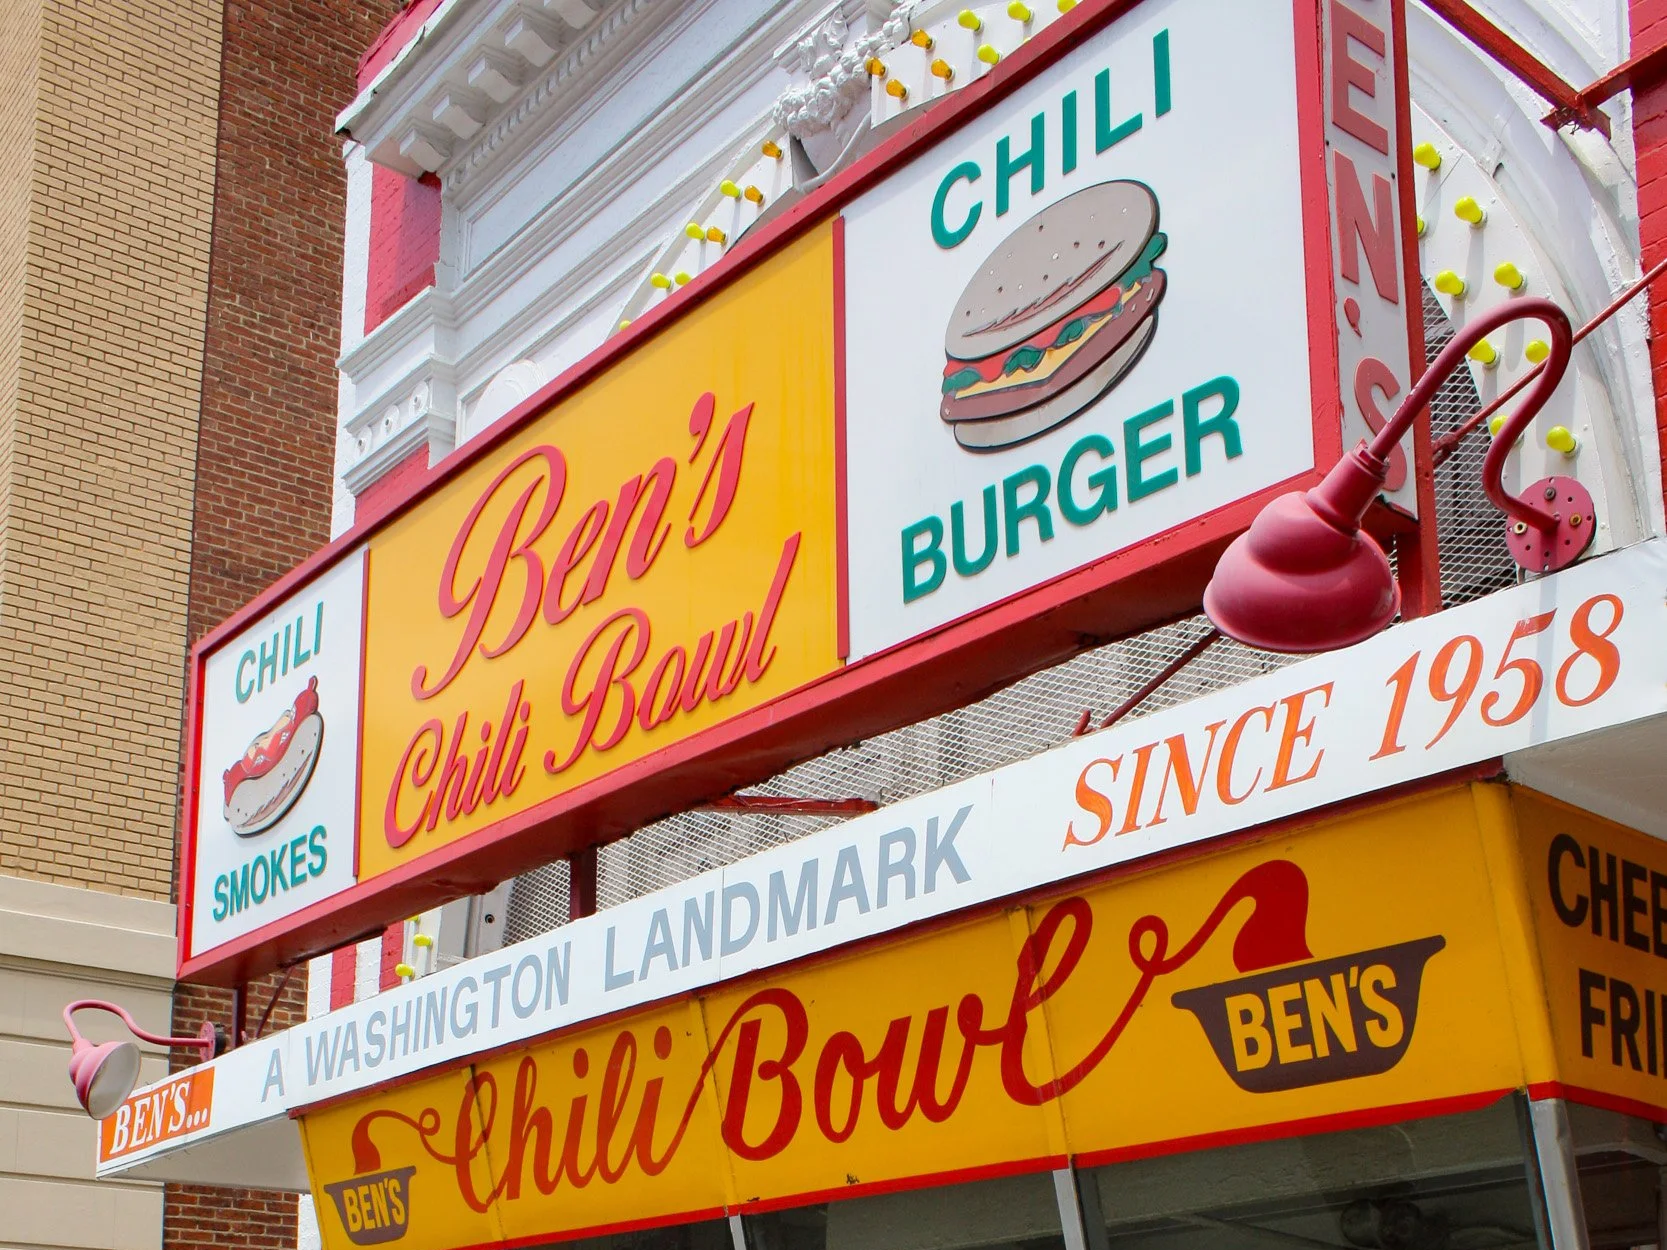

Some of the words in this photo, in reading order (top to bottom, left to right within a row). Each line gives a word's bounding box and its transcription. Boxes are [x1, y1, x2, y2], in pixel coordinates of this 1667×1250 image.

[930, 27, 1174, 251] CHILI
[411, 391, 755, 700] Ben's
[901, 374, 1244, 604] BURGER
[235, 601, 325, 704] CHILI
[384, 679, 531, 849] Chili
[543, 606, 802, 774] Bowl
[212, 824, 329, 923] SMOKES
[261, 1047, 286, 1103] A
[304, 941, 572, 1087] WASHINGTON
[604, 804, 974, 993] LANDMARK
[1062, 680, 1336, 852] SINCE
[1369, 591, 1627, 763] 1958
[455, 1022, 702, 1213] Chili
[720, 896, 1094, 1161] Bowl
[1225, 964, 1405, 1073] BEN'S
[1579, 968, 1667, 1080] FRI
[343, 1176, 406, 1234] BEN'S
